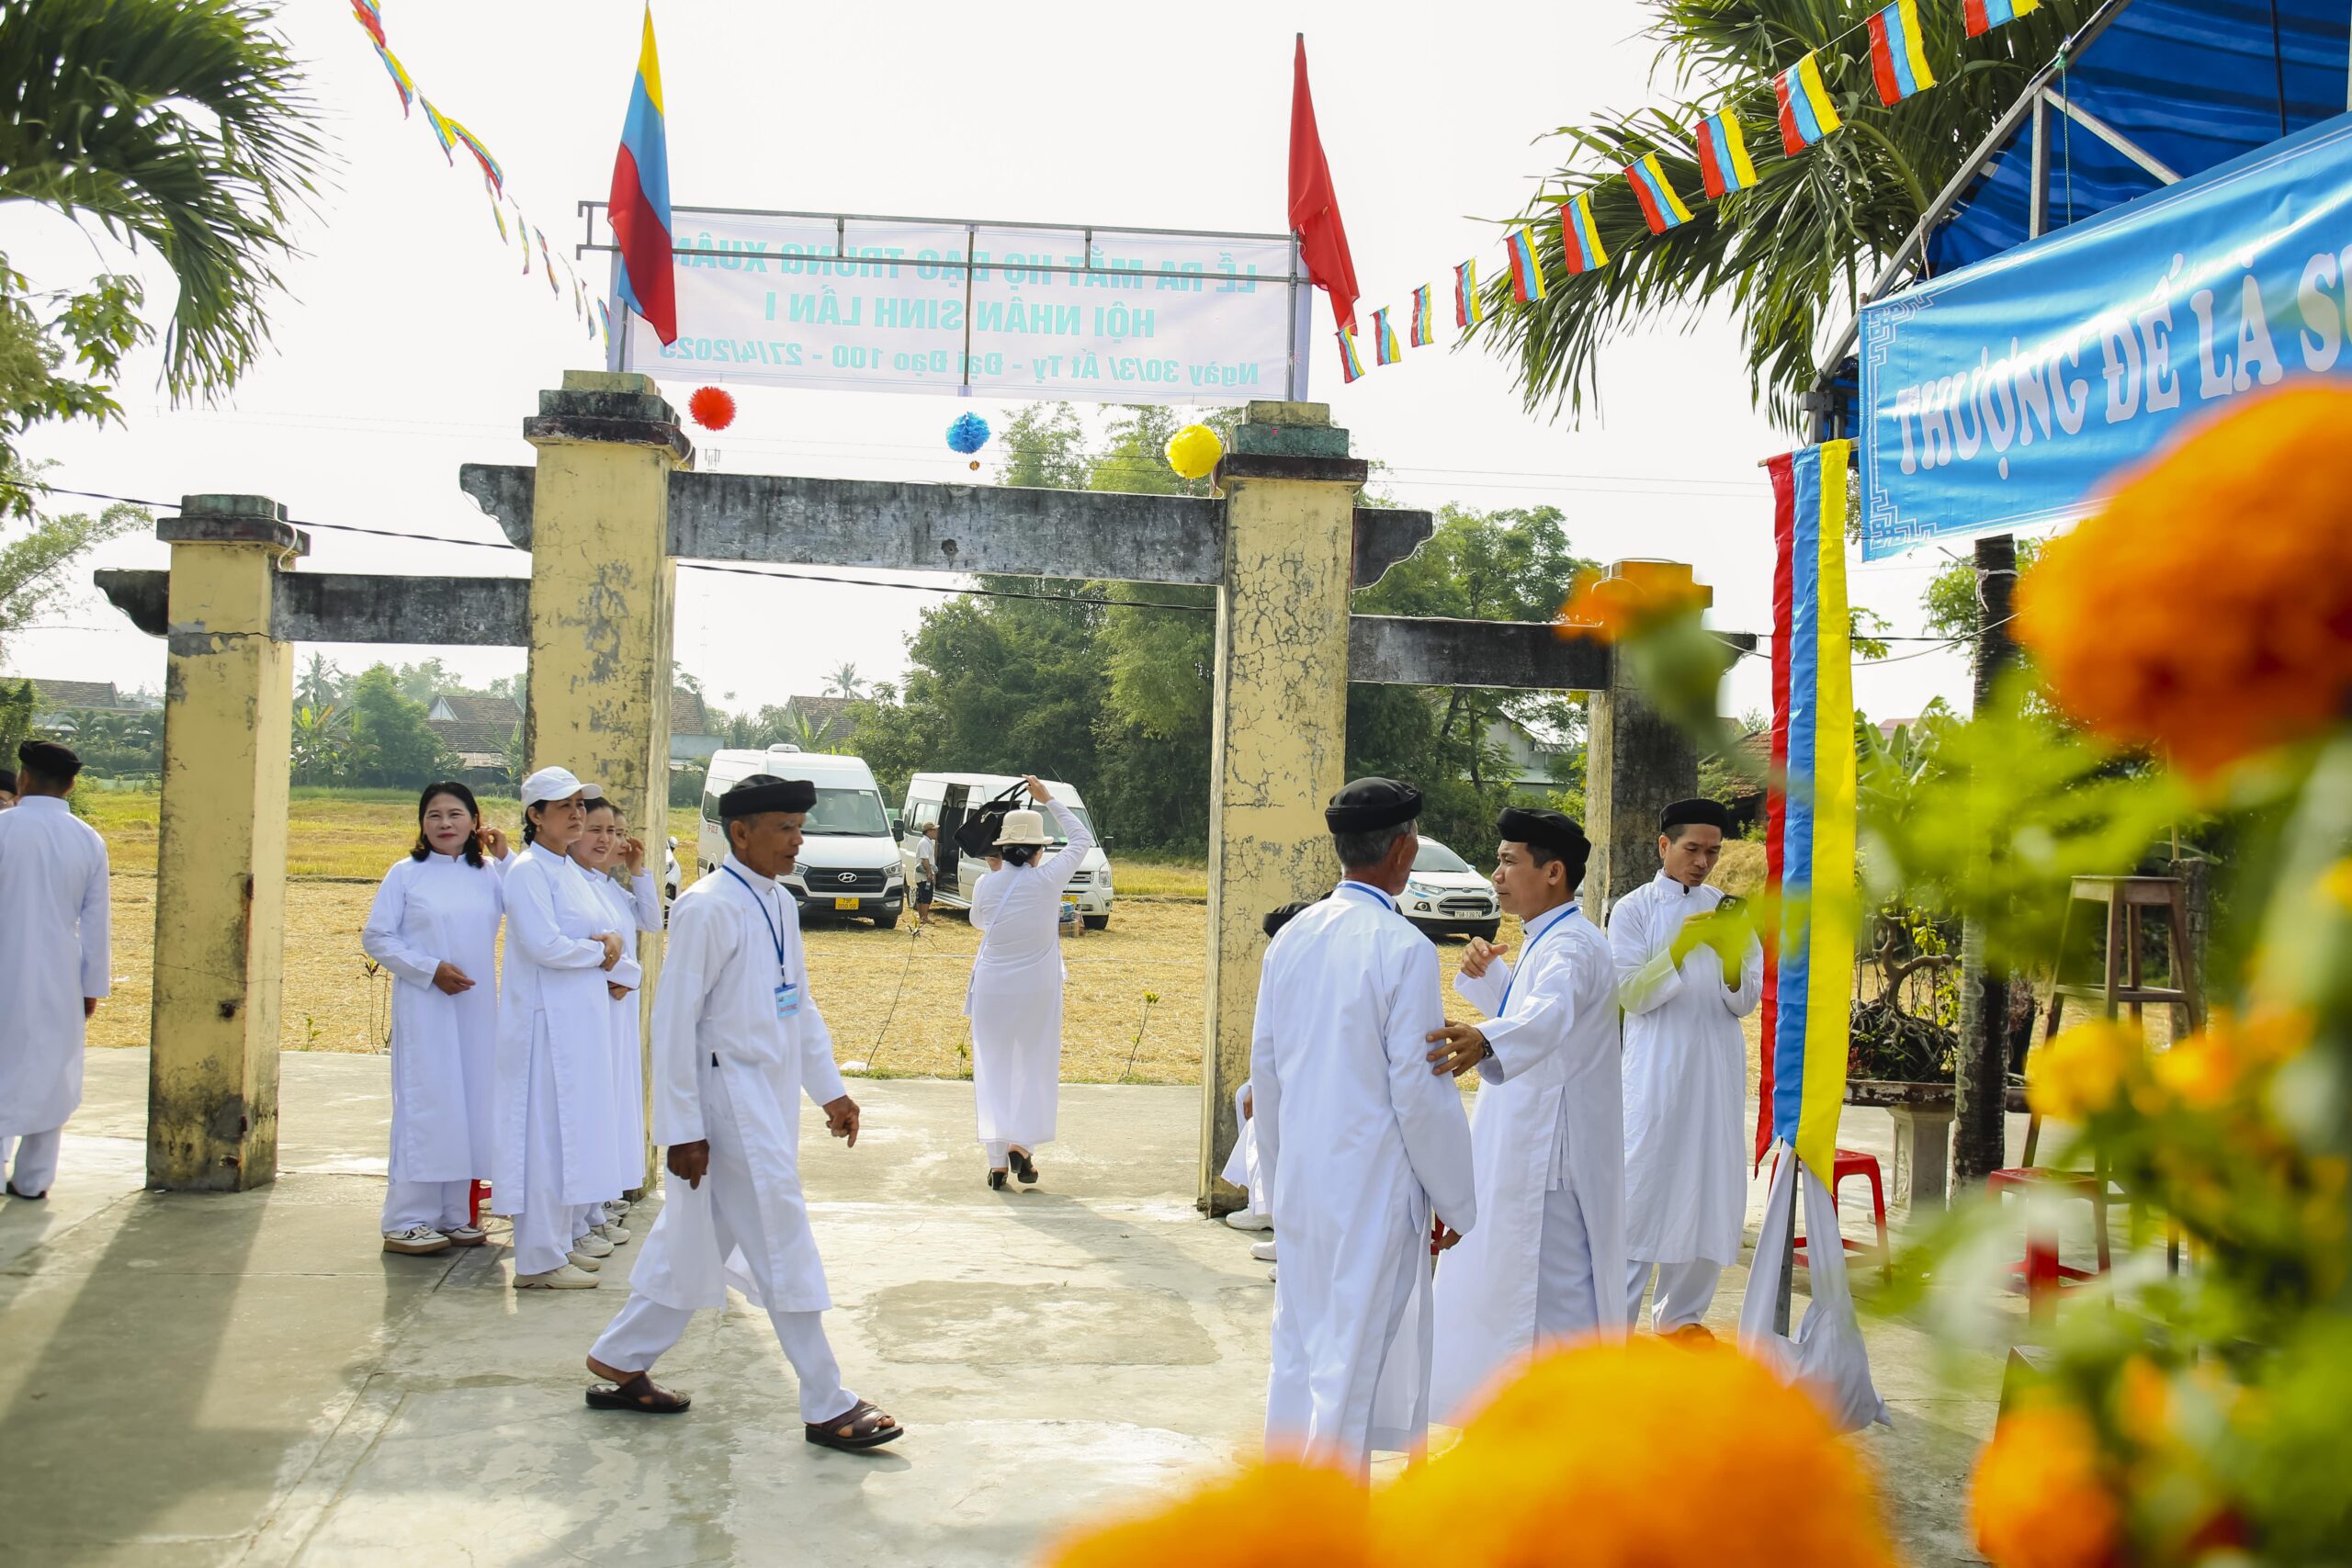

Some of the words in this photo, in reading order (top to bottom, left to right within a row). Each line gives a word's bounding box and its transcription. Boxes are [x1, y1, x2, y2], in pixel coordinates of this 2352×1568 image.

[1893, 337, 2089, 479] THƯỢNG
[2100, 253, 2184, 424] ĐẾ
[2298, 243, 2352, 373] S
